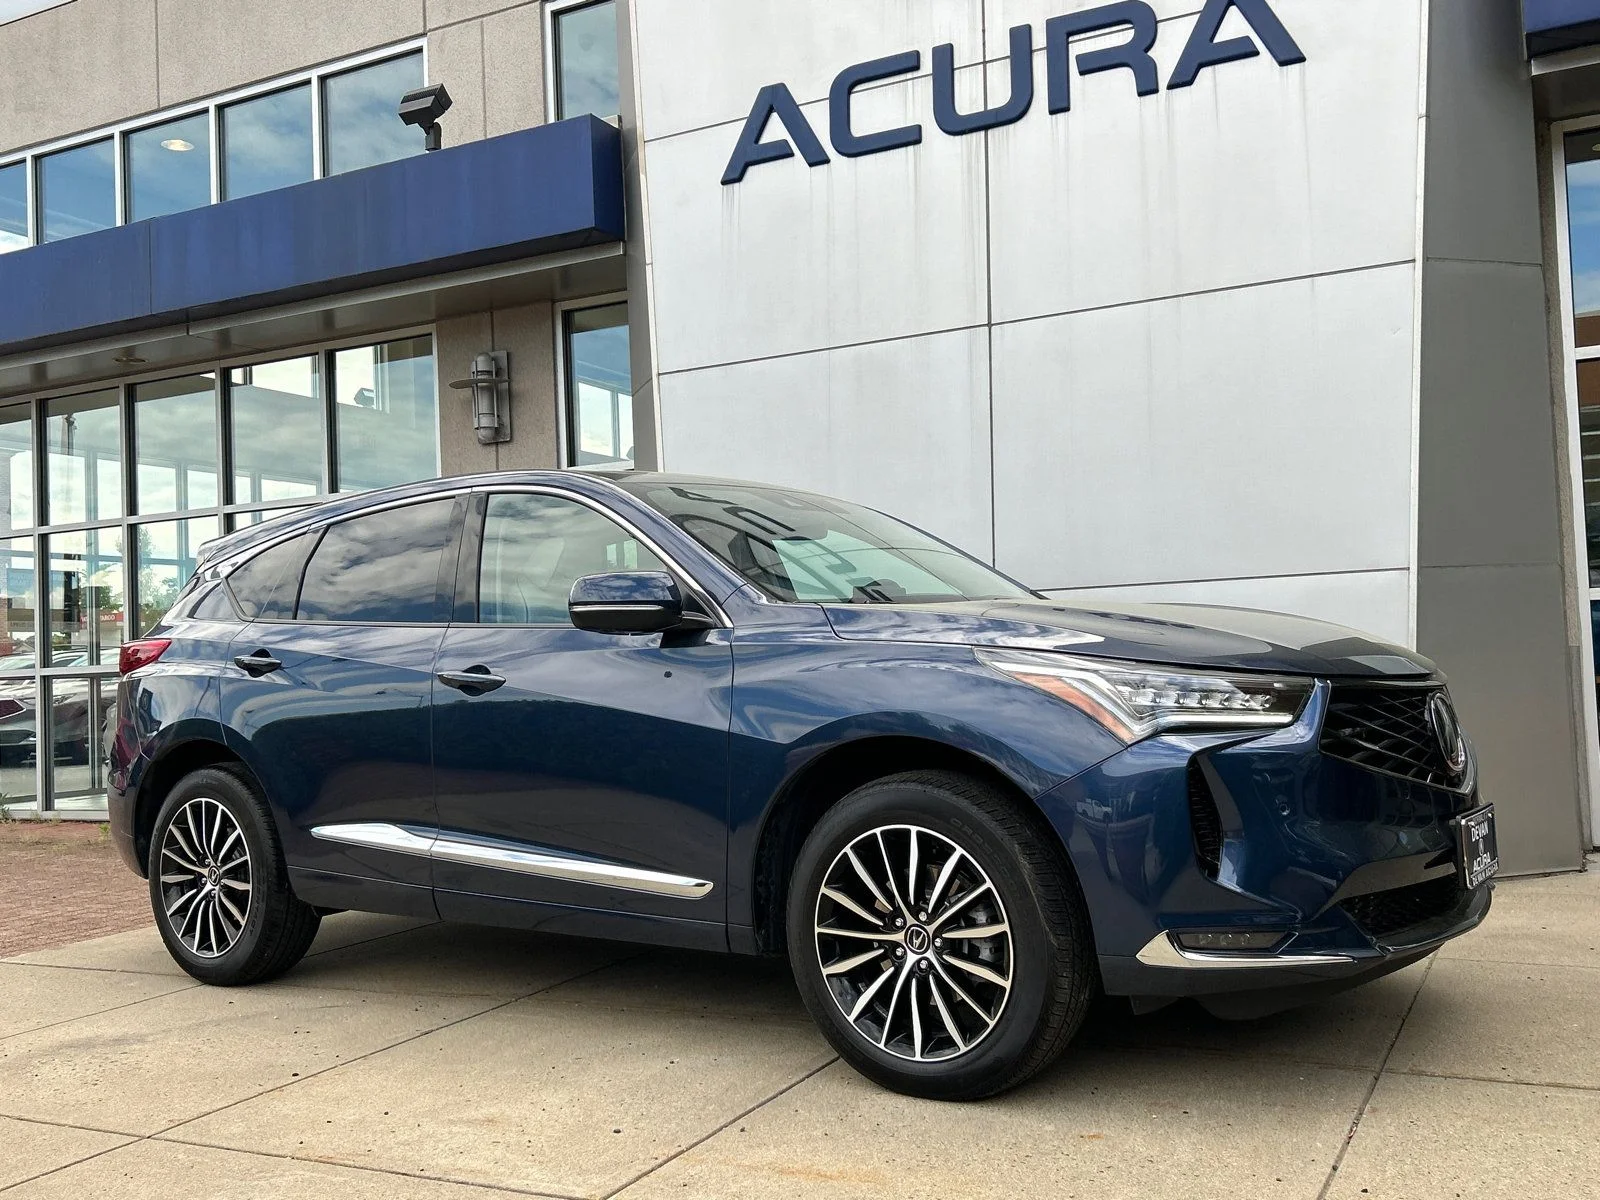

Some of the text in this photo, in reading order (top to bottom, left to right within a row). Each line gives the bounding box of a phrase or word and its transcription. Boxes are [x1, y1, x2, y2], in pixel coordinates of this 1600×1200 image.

[721, 0, 1306, 186] ACURA
[1471, 821, 1489, 842] DEVAN
[1473, 852, 1491, 872] ACURA
